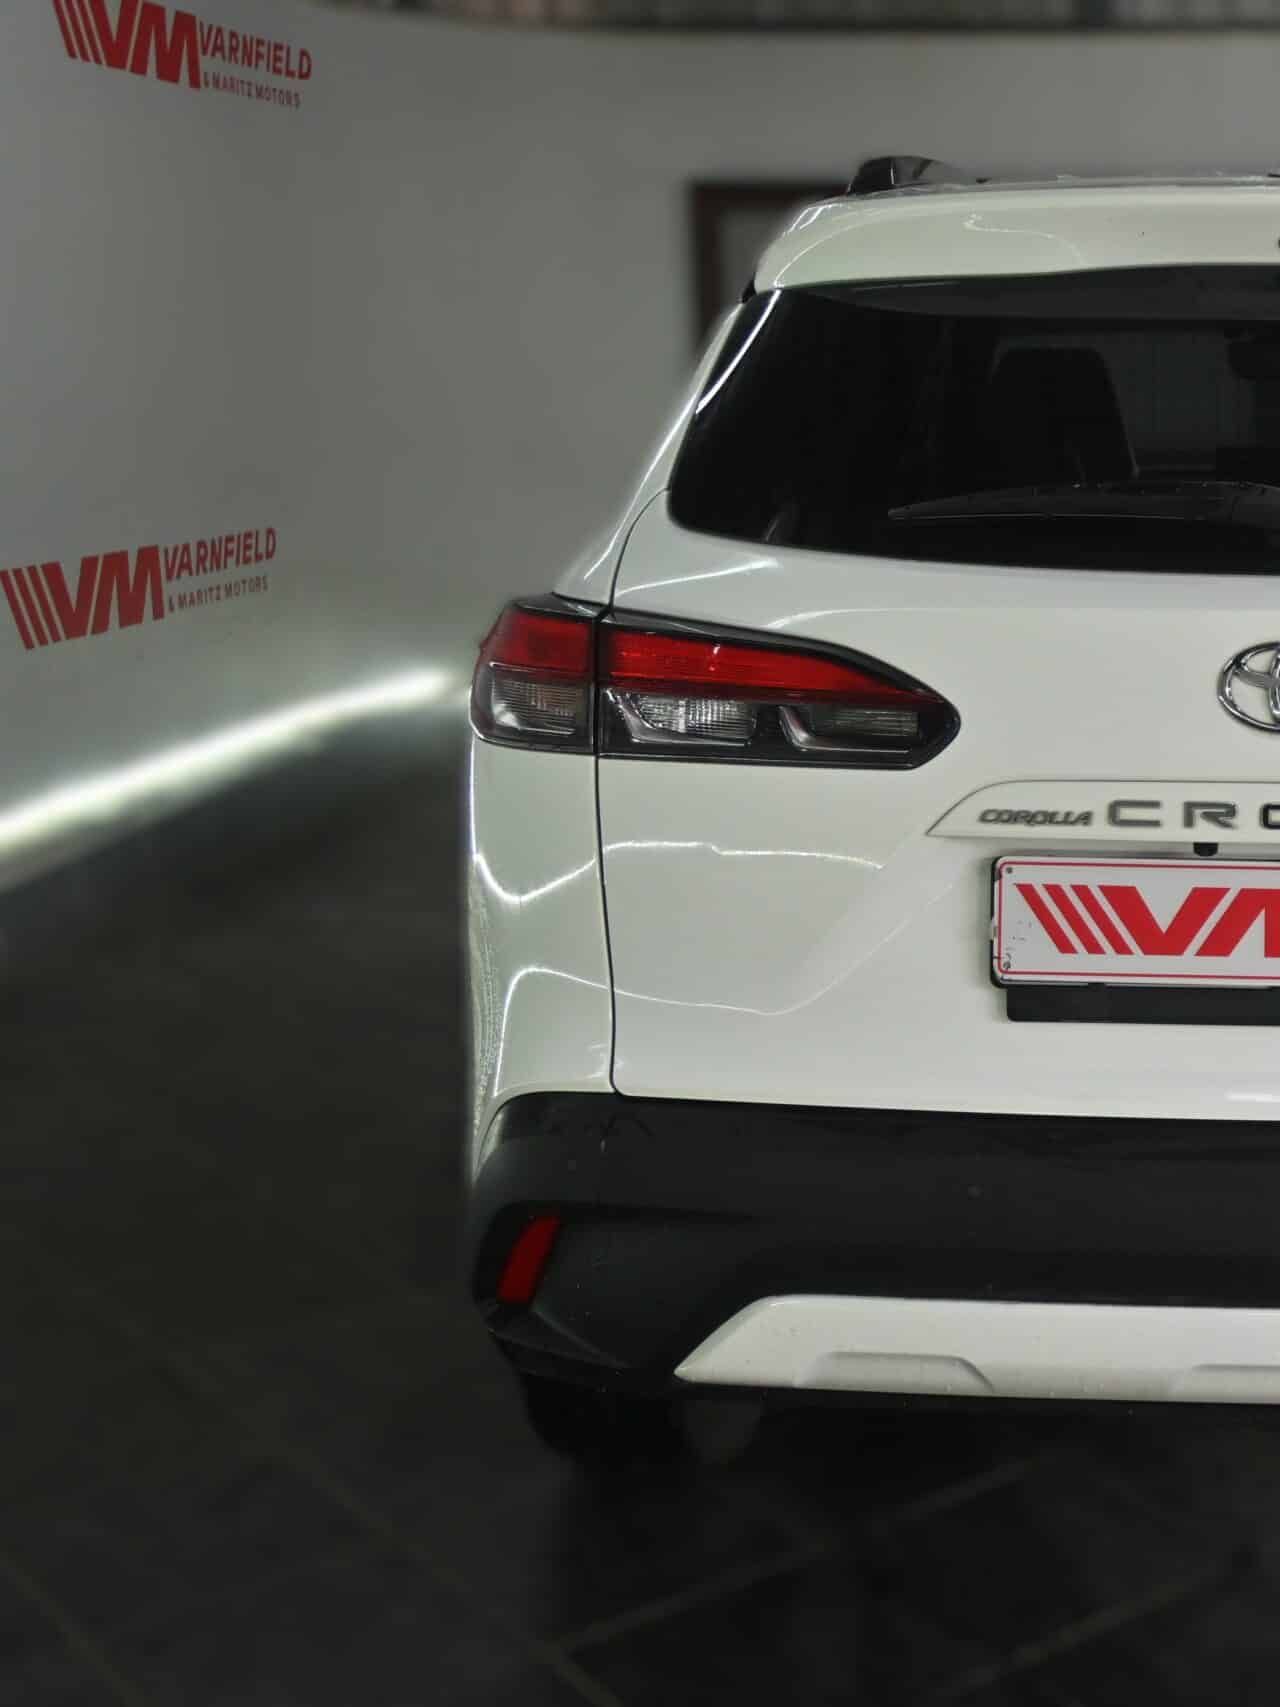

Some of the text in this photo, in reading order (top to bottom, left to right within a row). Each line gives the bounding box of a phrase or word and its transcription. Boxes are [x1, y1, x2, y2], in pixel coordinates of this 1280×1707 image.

[199, 20, 312, 80] VARNFIELD
[255, 84, 301, 109] MOTORS
[164, 528, 276, 582] VARNFIELD
[178, 585, 221, 609] MARITZ
[224, 576, 268, 597] MOTORS
[979, 809, 1093, 827] COROLLA
